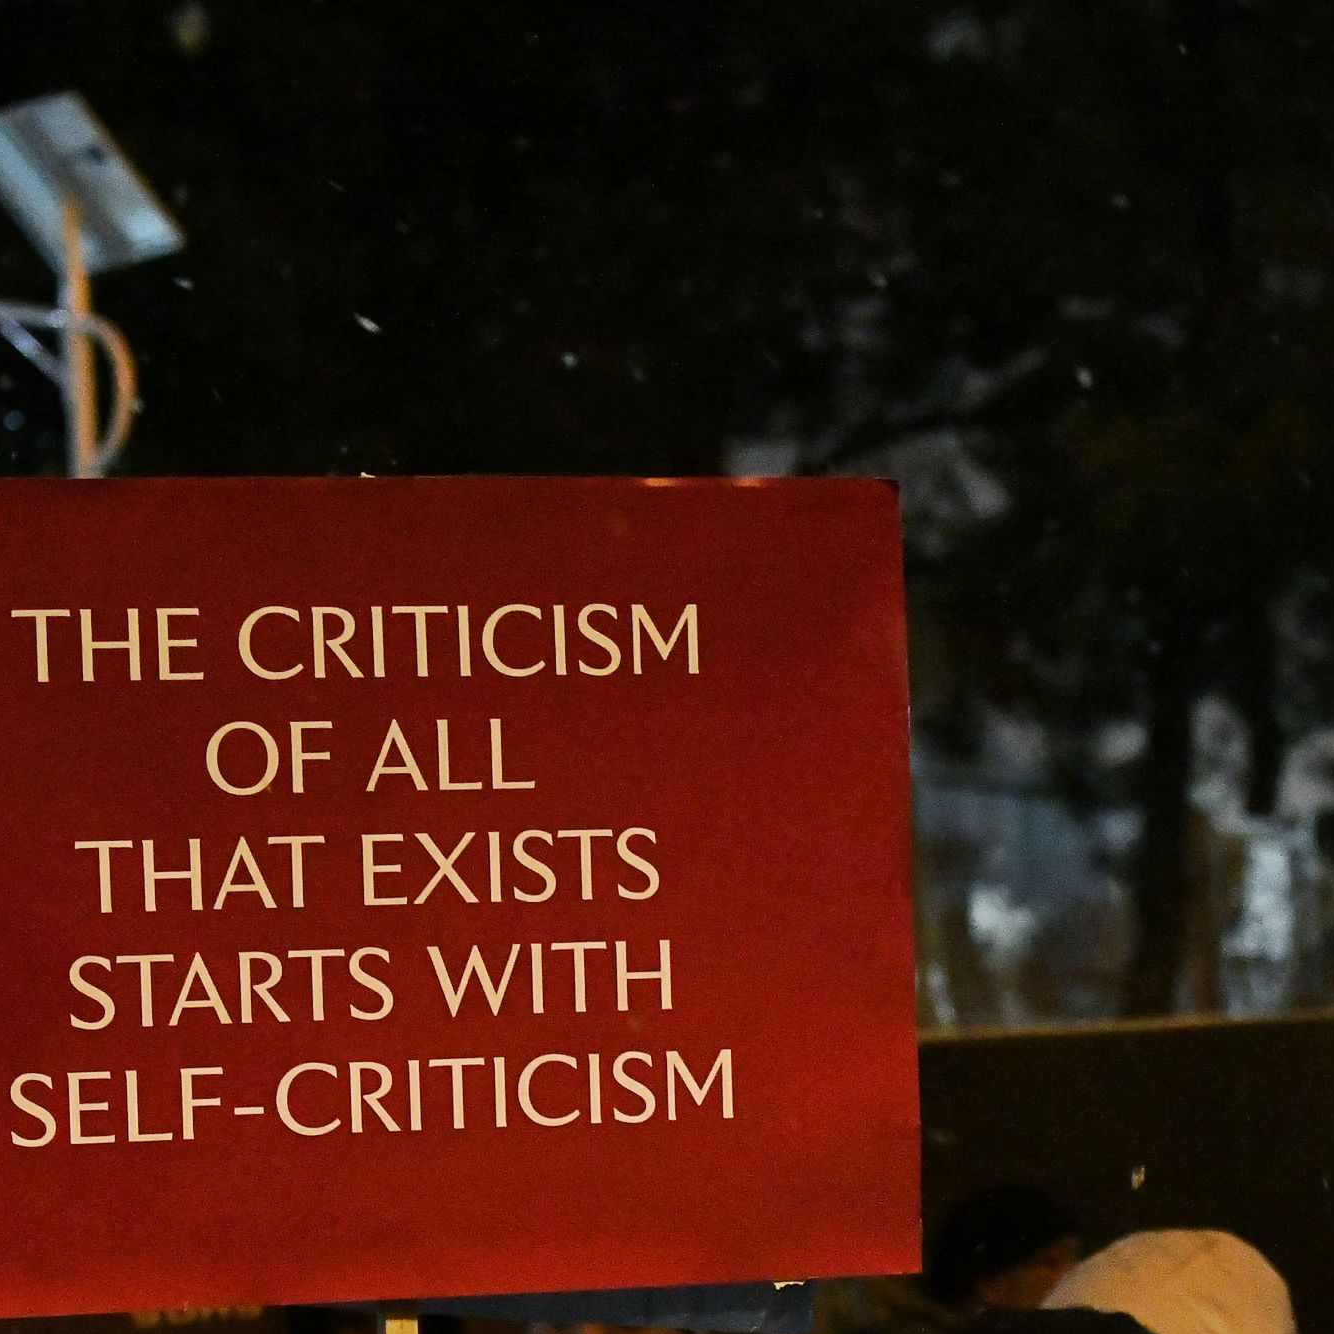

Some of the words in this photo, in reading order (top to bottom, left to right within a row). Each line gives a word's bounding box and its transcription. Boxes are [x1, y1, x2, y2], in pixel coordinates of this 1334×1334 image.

[11, 607, 204, 683] THE
[238, 603, 700, 680] CRITICISM
[205, 720, 333, 796] OF
[365, 718, 536, 792] ALL
[74, 835, 326, 914] THAT
[361, 827, 660, 906] EXISTS
[69, 946, 394, 1030] STARTS
[426, 939, 673, 1018] WITH
[10, 1048, 734, 1148] SELF-CRITICISM
